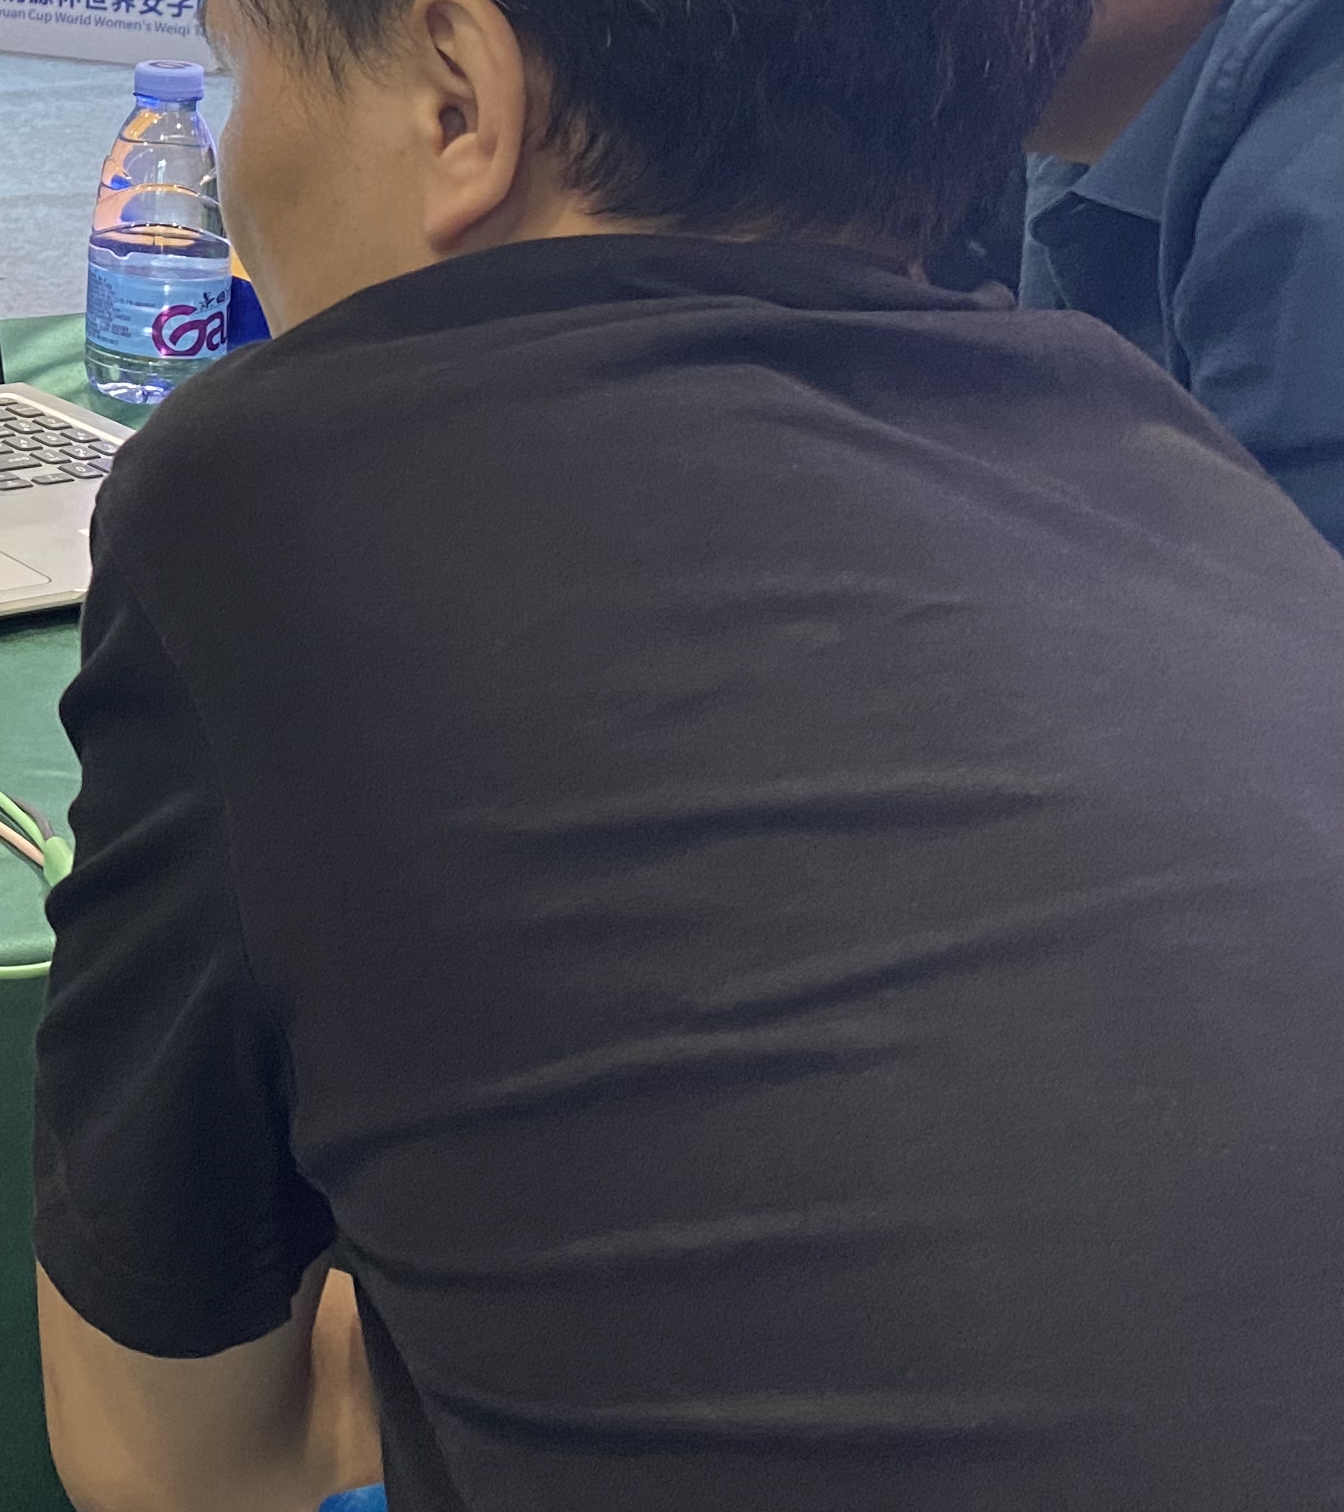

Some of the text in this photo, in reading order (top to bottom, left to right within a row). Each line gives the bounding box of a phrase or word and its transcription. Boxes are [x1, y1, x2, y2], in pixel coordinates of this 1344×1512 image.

[28, 8, 53, 25] Cup
[55, 11, 92, 26] World
[94, 15, 152, 32] Women's
[154, 21, 191, 38] Weiqi
